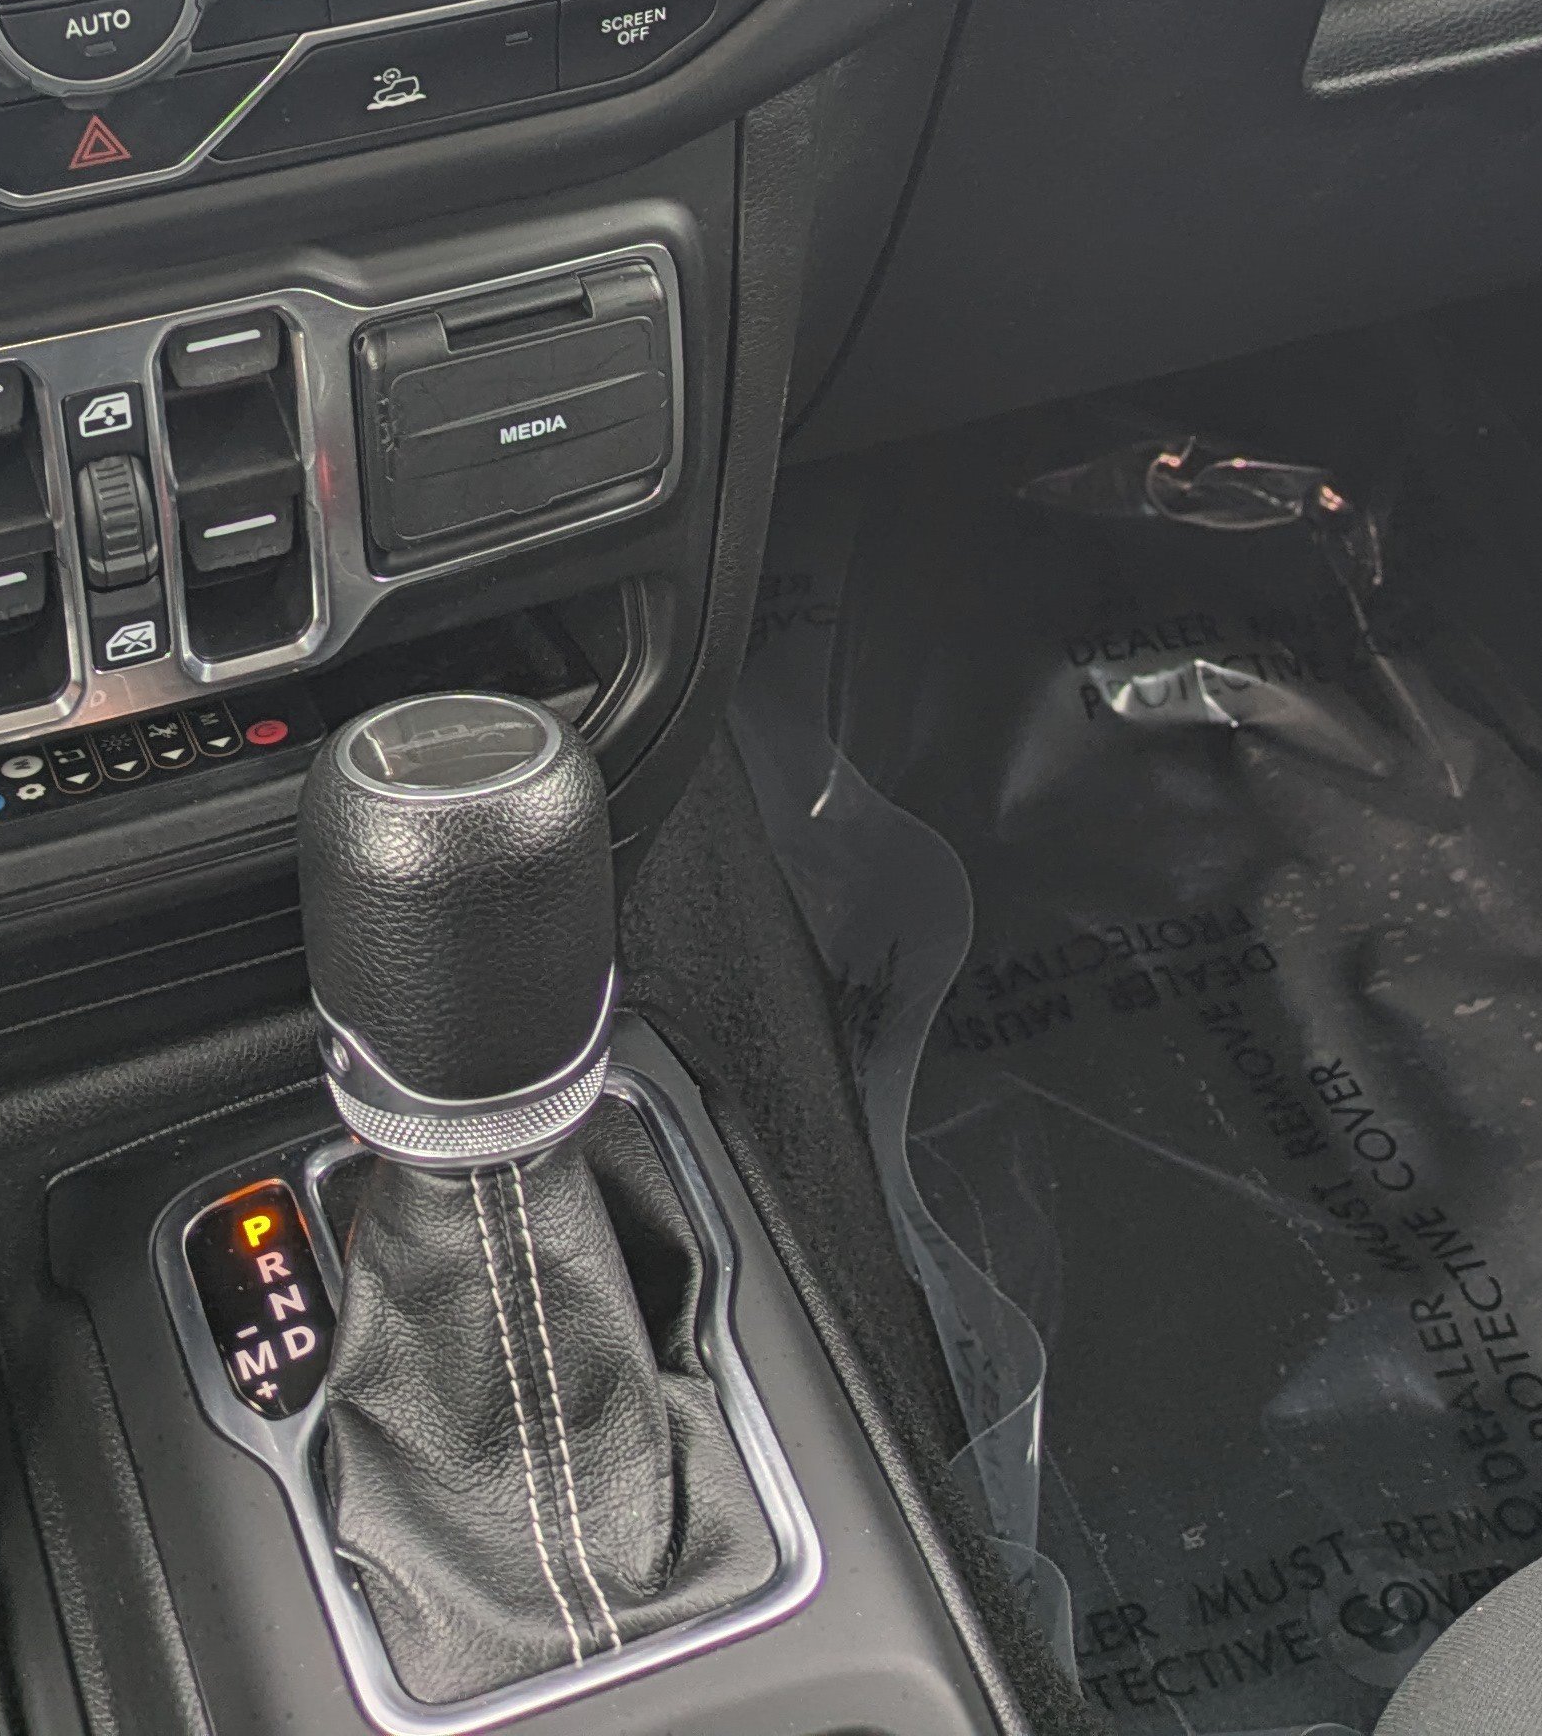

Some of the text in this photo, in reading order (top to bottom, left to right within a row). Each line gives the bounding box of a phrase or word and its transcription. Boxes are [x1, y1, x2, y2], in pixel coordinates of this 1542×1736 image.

[65, 8, 131, 40] AUTO
[601, 6, 667, 34] SCREEN
[617, 26, 650, 46] OFF
[500, 414, 567, 445] MEDIA
[1308, 1058, 1417, 1193] COVER
[242, 1215, 272, 1248] P
[256, 1251, 291, 1284] R
[268, 1283, 306, 1321] N
[281, 1325, 316, 1360] D
[234, 1340, 278, 1381] M
[1410, 1291, 1527, 1488] DEALER
[1192, 1530, 1355, 1625] MUST
